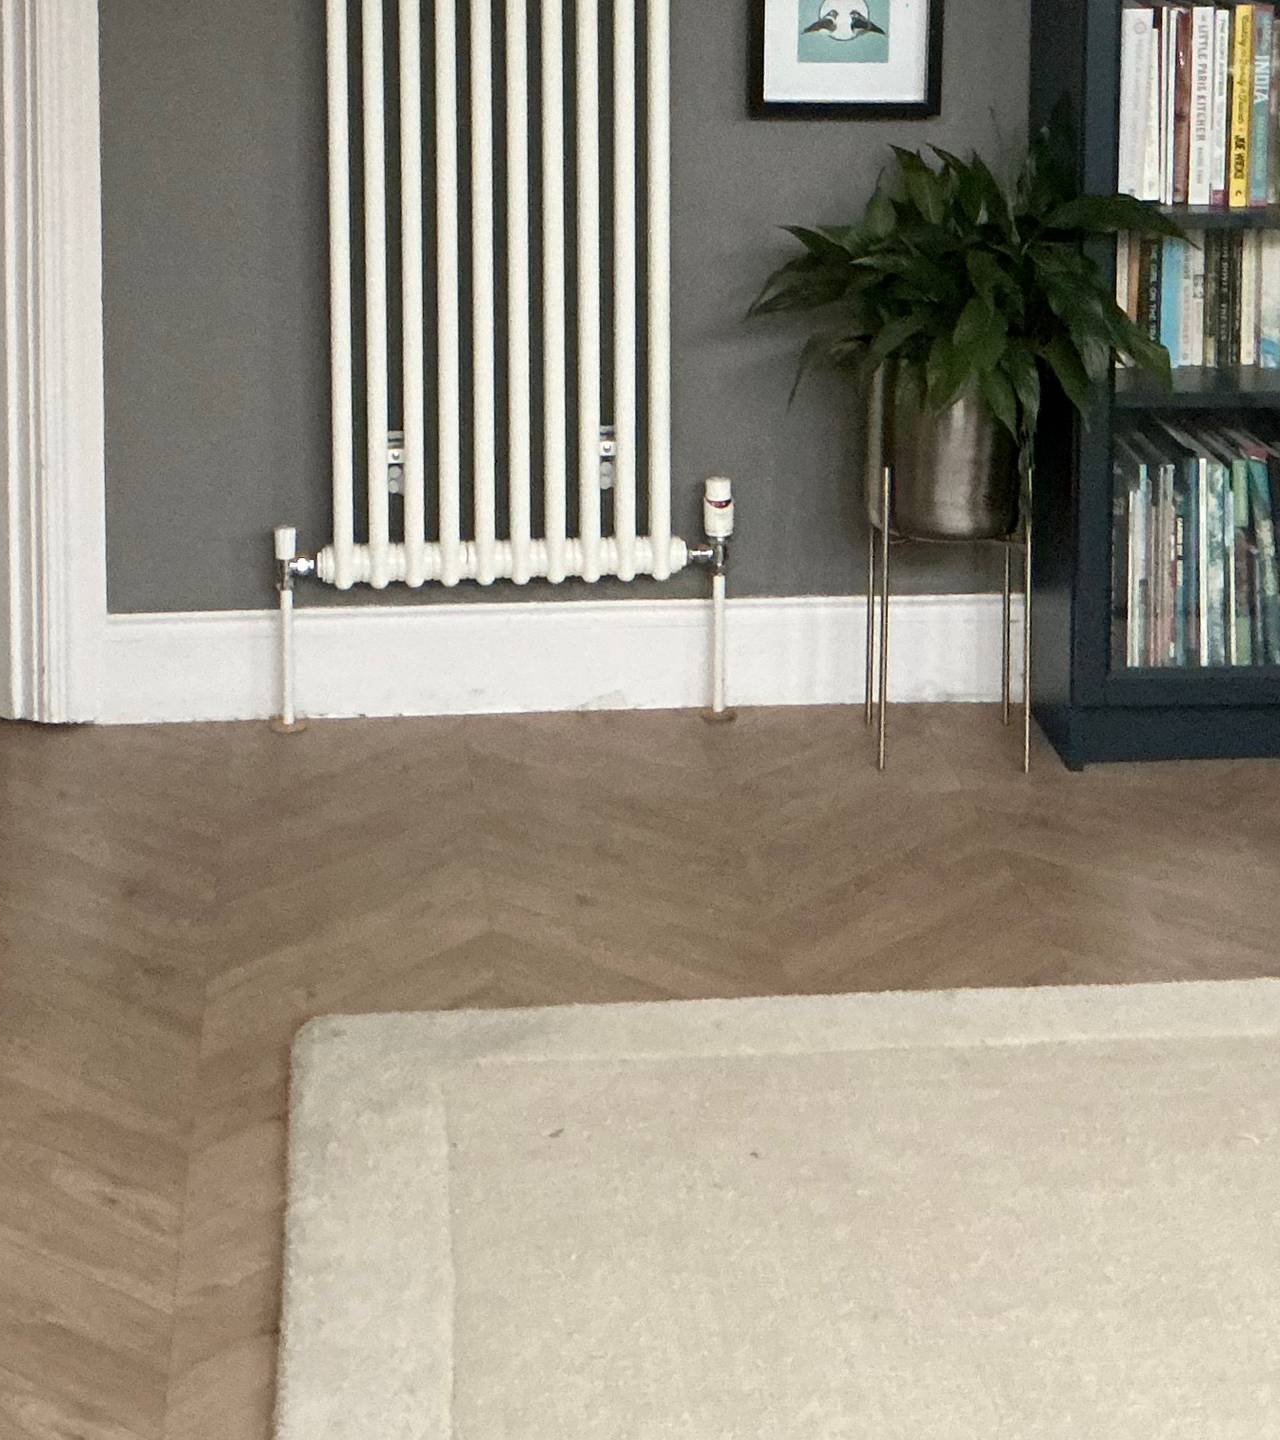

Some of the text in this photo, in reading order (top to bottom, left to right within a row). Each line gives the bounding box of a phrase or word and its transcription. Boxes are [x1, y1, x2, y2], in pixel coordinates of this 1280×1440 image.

[1198, 25, 1209, 60] LITTLE
[1197, 63, 1207, 90] PARIS
[1253, 55, 1270, 104] INDIA
[1196, 95, 1207, 141] KITCHEN
[1149, 287, 1157, 301] ON
[1149, 303, 1157, 321] THE
